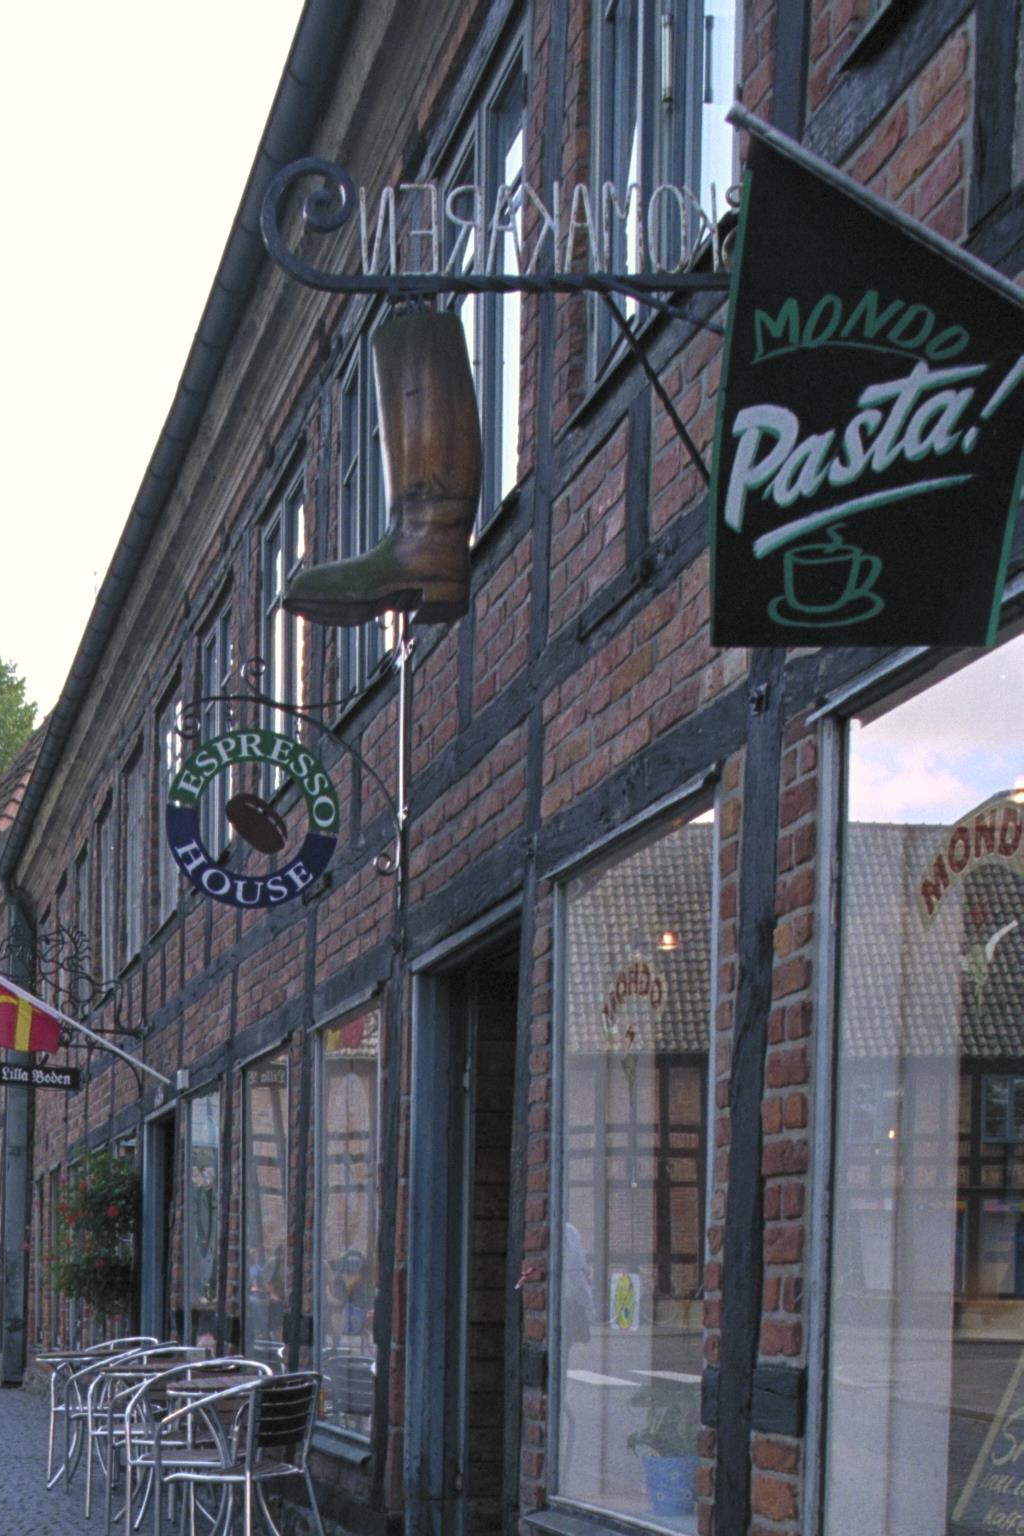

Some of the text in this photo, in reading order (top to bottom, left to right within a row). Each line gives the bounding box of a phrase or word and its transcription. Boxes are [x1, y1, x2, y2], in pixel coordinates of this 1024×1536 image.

[753, 288, 970, 361] MONDO
[724, 352, 1024, 534] Pasta!
[177, 733, 336, 828] ESPRESSO
[174, 839, 314, 905] HOUSE
[1, 1066, 72, 1087] Lilla Boden
